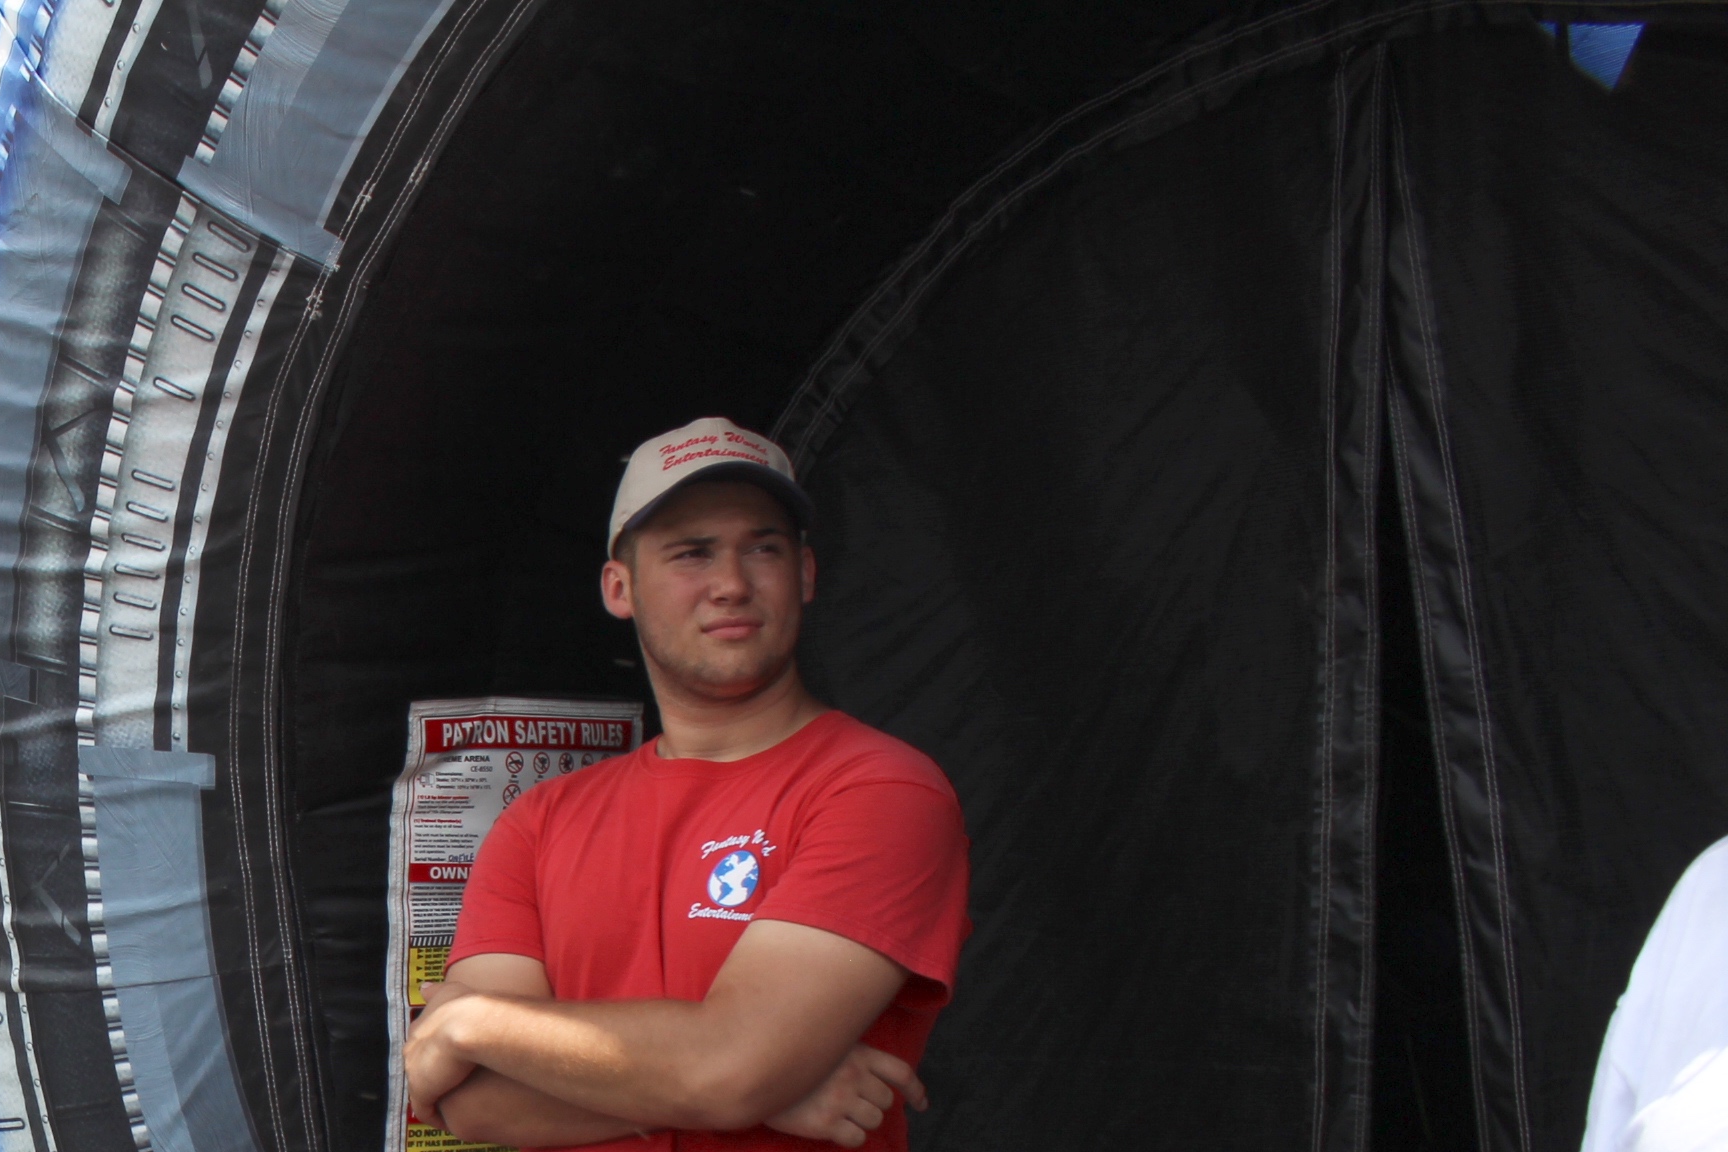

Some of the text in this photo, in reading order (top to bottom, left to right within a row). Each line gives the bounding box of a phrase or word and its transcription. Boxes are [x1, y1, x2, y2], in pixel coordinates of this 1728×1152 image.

[659, 434, 720, 457] Fantasy
[662, 448, 769, 471] Entertainment
[442, 720, 624, 747] PATRON SAFETY RULES
[430, 867, 472, 879] OWN
[408, 1130, 422, 1138] DO
[424, 1129, 442, 1137] NOT
